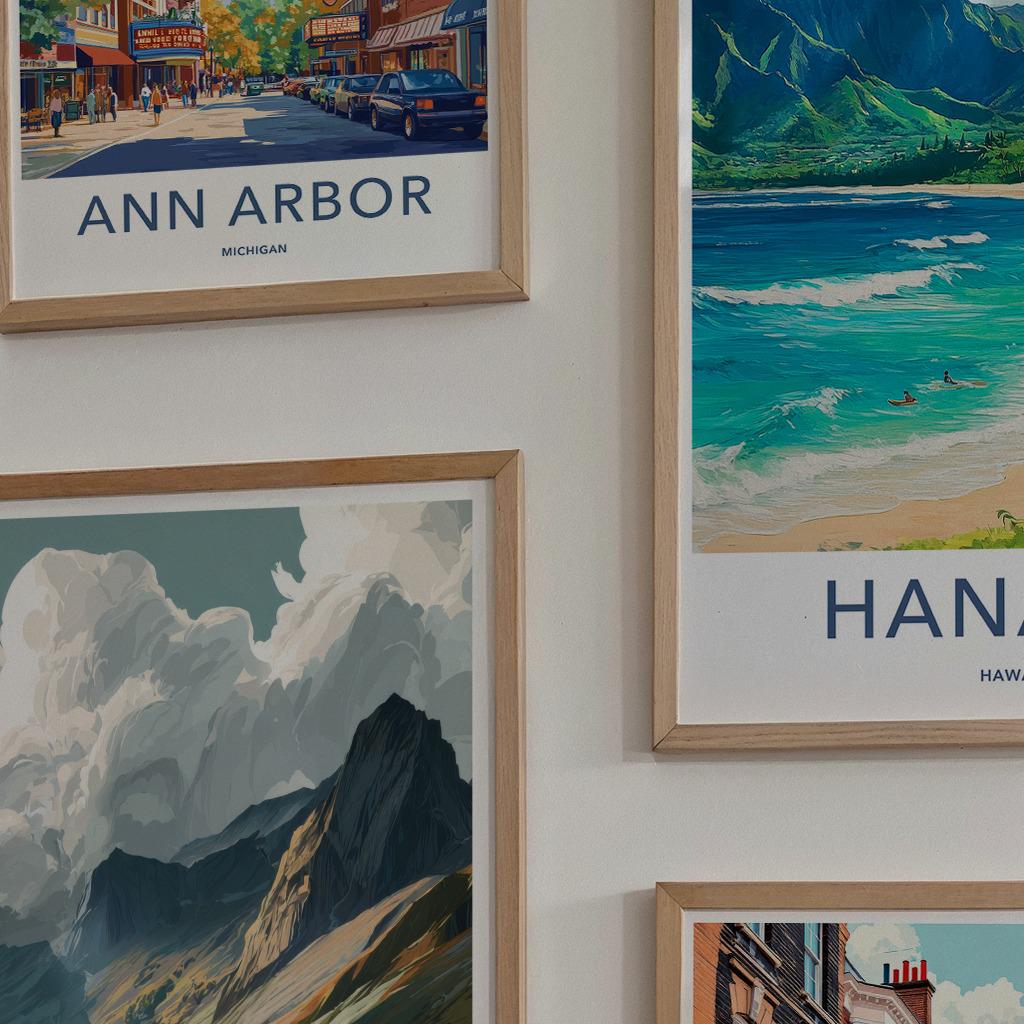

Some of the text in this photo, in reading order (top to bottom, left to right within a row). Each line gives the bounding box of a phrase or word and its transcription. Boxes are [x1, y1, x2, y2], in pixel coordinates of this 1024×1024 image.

[77, 175, 432, 236] ANN ARBOR
[221, 242, 288, 257] MICHIGAN
[827, 577, 1024, 639] HAN
[980, 669, 1024, 682] HAW
